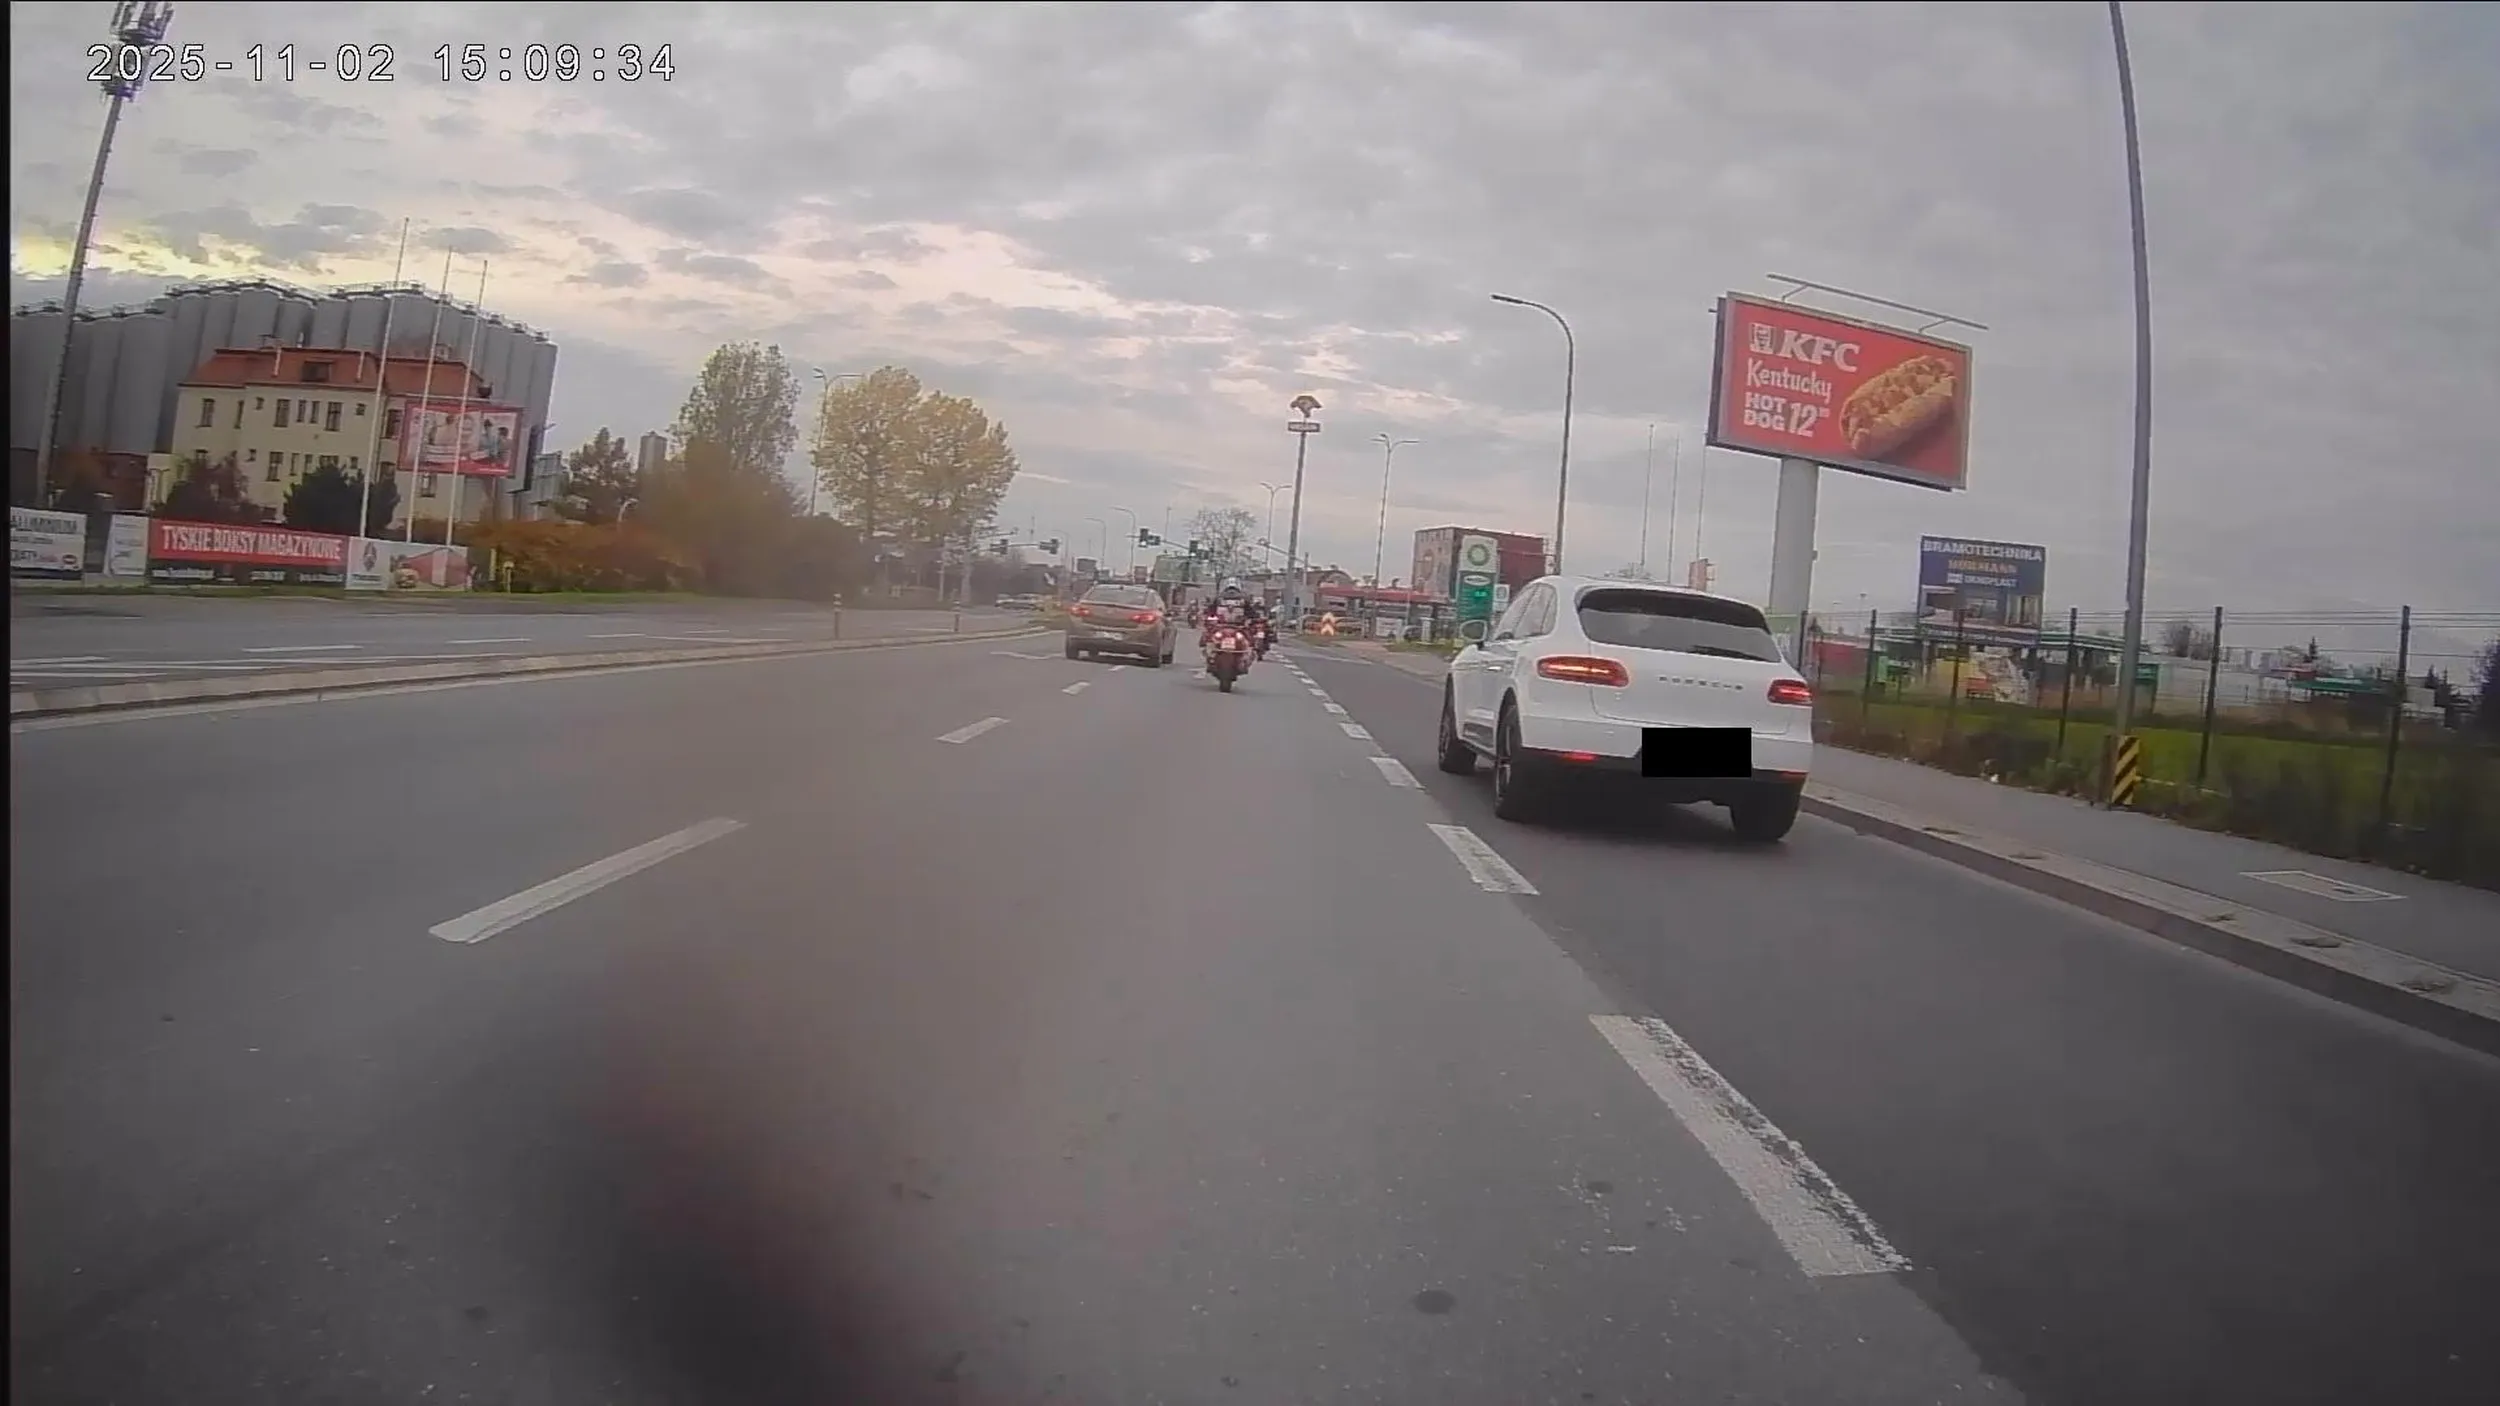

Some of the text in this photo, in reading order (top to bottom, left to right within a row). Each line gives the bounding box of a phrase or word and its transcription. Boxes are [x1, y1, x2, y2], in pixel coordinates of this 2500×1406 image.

[1777, 329, 1860, 372] KFC
[1747, 357, 1832, 404] Kentucky
[1745, 392, 1786, 411] HOT
[1744, 410, 1785, 430] DOG
[162, 525, 212, 551] TYSKIE
[214, 528, 257, 554] BOKSY
[258, 532, 342, 560] MAGAZYNOWE
[1923, 540, 2041, 560] BRAMOTECHNIKA
